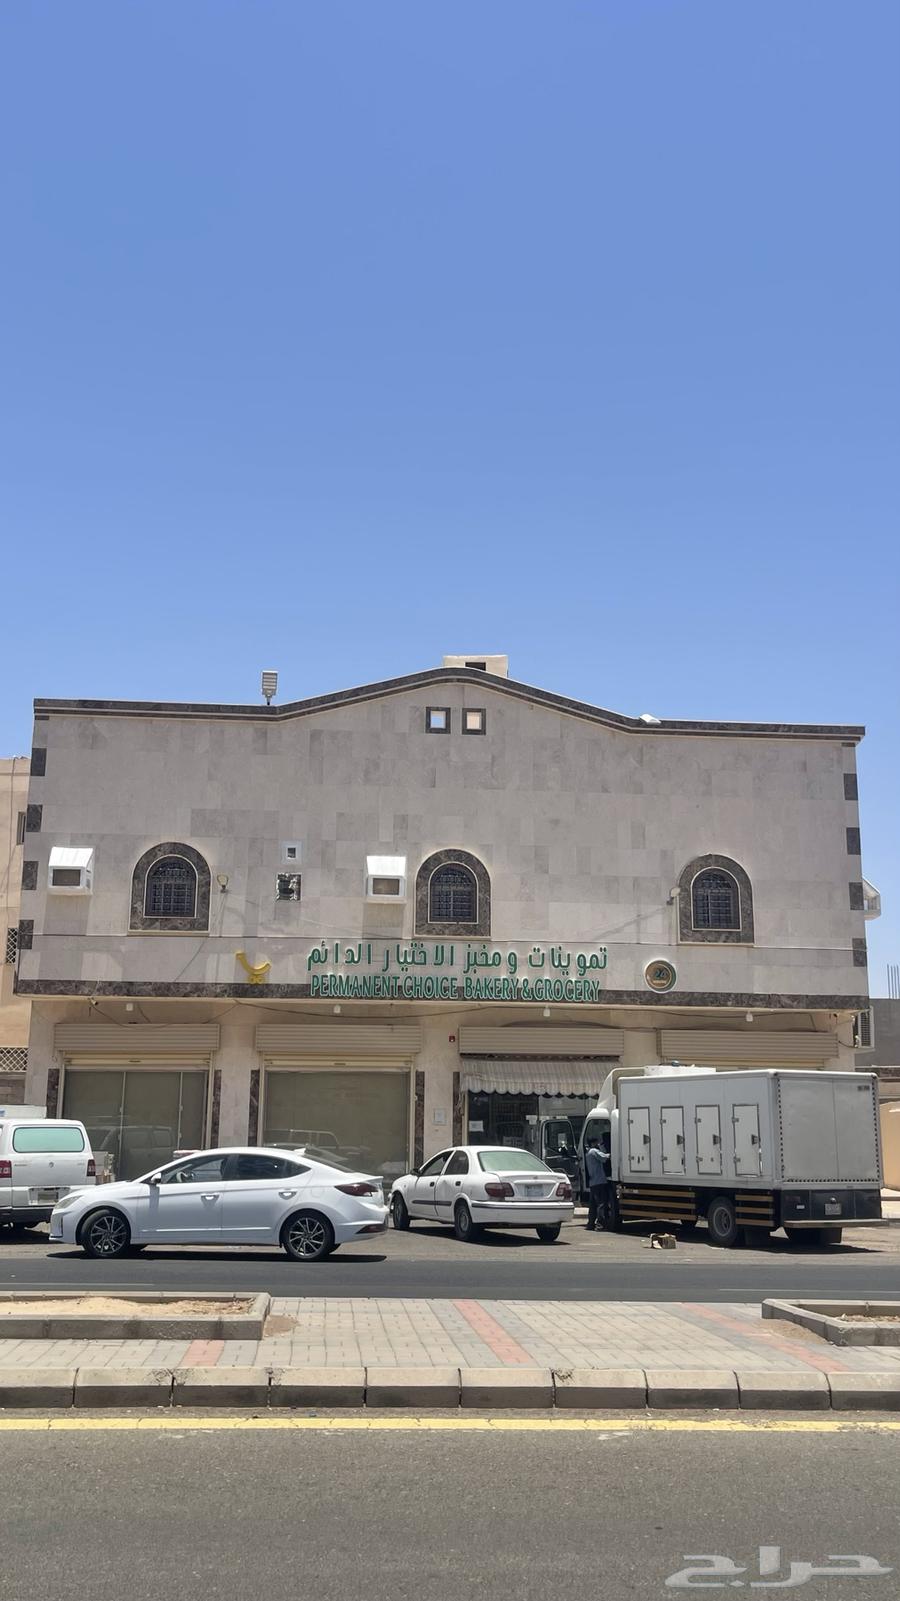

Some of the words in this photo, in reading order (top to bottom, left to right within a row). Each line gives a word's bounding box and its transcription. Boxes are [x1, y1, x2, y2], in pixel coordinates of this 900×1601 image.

[306, 940, 373, 972] الدائم
[381, 941, 455, 972] الاختيار
[528, 946, 608, 976] تموينات
[310, 974, 400, 997] PERMANENT
[403, 976, 459, 998] CHOICE
[464, 976, 519, 999] BAKERY
[522, 977, 533, 1000] &
[534, 978, 600, 1001] GROCERY
